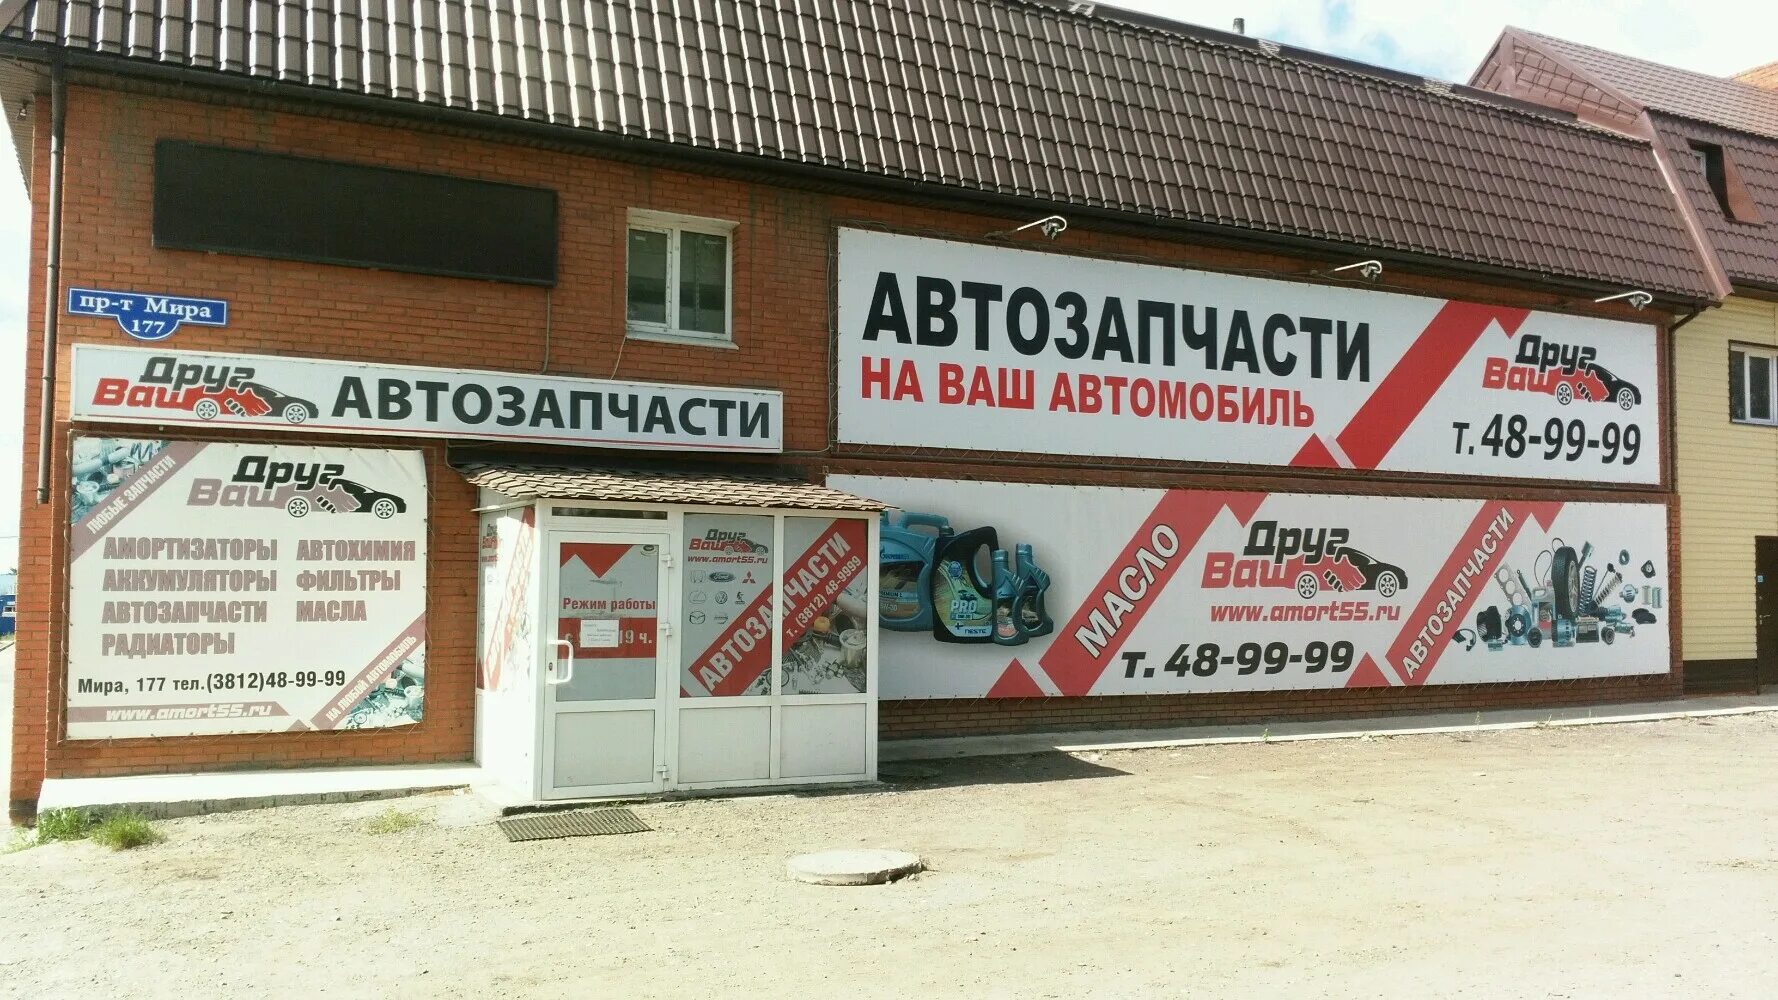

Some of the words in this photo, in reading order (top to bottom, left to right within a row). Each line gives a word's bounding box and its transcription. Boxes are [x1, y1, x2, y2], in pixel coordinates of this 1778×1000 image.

[79, 295, 133, 313] пр-т
[144, 297, 212, 321] Мира
[131, 319, 166, 335] 177
[862, 271, 1370, 383] АВТОЗАПЧАСТИ
[1514, 334, 1597, 374] Друг
[139, 356, 256, 393] Друг
[1482, 357, 1550, 394] Ваш
[91, 377, 190, 409] Ваш
[331, 375, 770, 439] АВТОЗАПЧАСТИ
[860, 356, 923, 403] НА
[937, 362, 1035, 410] ВАШ
[1048, 372, 1315, 429] АВТОМОБИЛЬ
[231, 456, 345, 490] Друг
[86, 496, 128, 535] ЛЮБЫЕ
[123, 455, 176, 501] ЗАПЧАСТИ
[186, 478, 281, 507] Ваш
[103, 537, 278, 561] АМОРТИЗАТОРЫ
[296, 539, 416, 561] АВТОХИМИЯ
[1243, 520, 1350, 565] Друг
[687, 555, 768, 564] www.amort55.ru
[1200, 551, 1292, 590] Ваш
[102, 569, 277, 592] АККУМУЛЯТОРЫ
[296, 569, 401, 592] ФИЛЬТРЫ
[796, 593, 828, 628] (3812)
[825, 555, 861, 596] 48-9999
[1074, 523, 1180, 660] МАСЛО
[1402, 507, 1515, 680] АВТОЗАПЧАСТИ
[101, 601, 267, 624] АВТОЗАПЧАСТИ
[296, 600, 367, 622] МАСЛА
[562, 597, 607, 610] Режим
[610, 597, 656, 613] работы
[1209, 600, 1401, 622] www.amort55.ru
[101, 632, 235, 659] РАДИАТОРЫ
[1163, 640, 1355, 678] 48-99-99
[77, 678, 129, 696] Мира,
[136, 677, 166, 692] 177
[105, 703, 272, 721] www.amort55.ru
